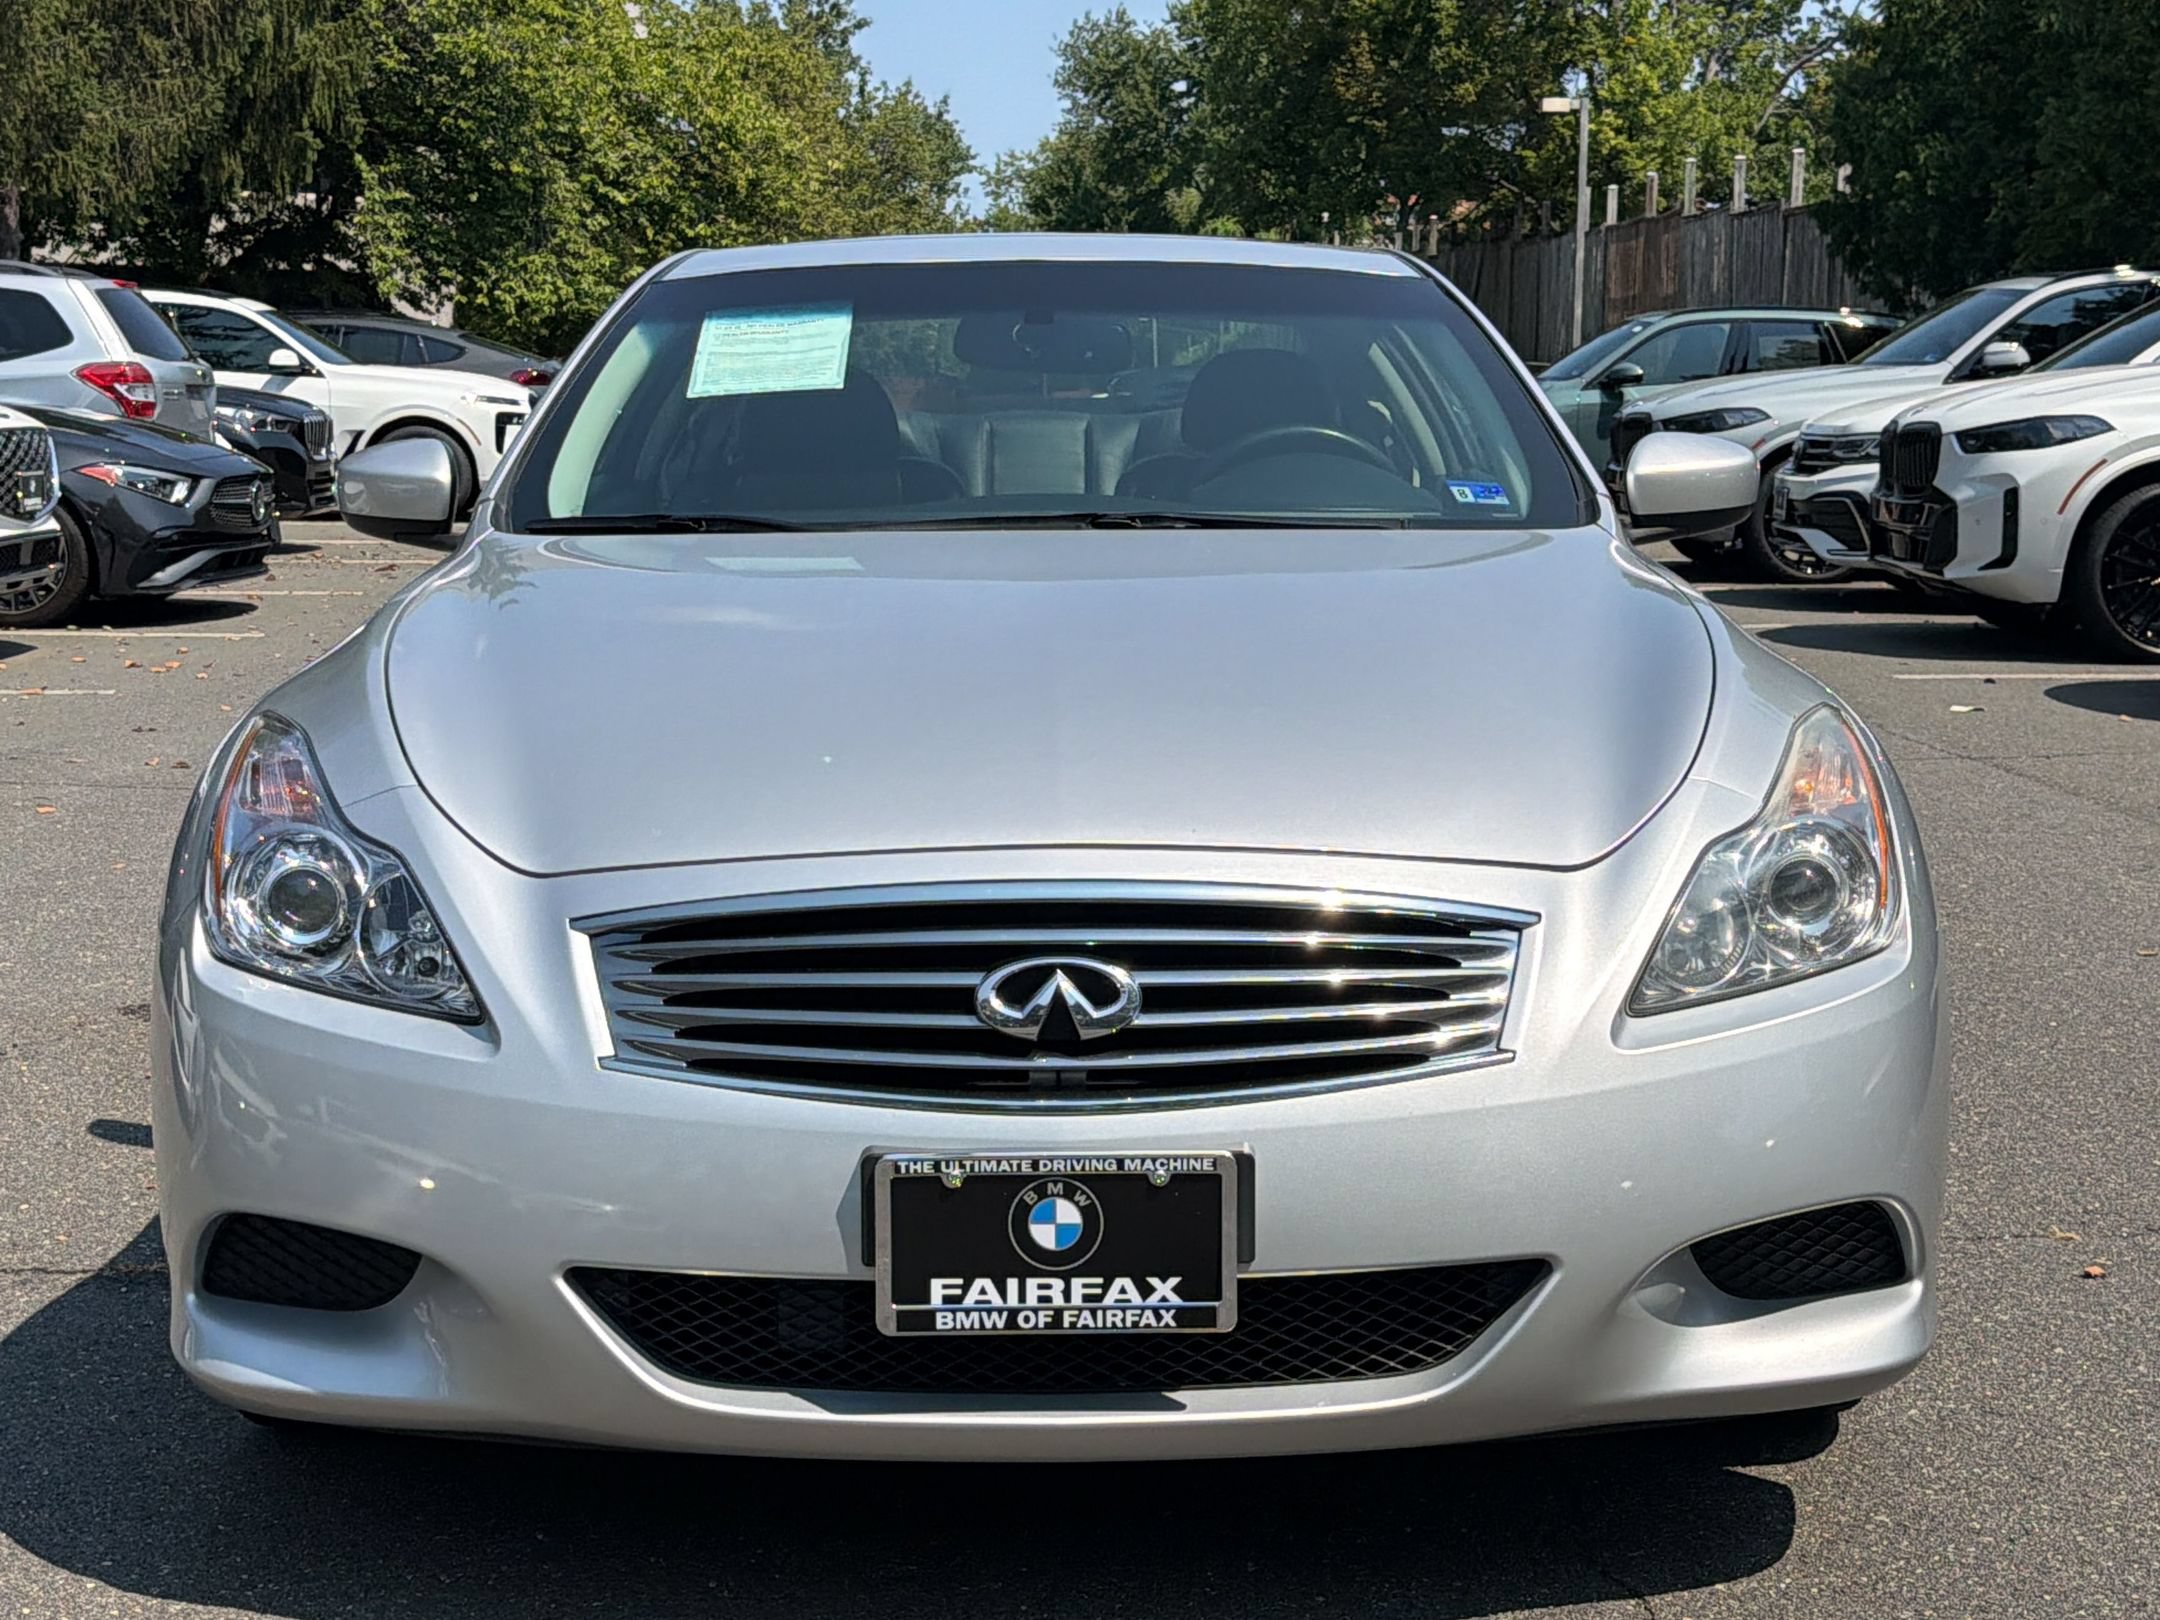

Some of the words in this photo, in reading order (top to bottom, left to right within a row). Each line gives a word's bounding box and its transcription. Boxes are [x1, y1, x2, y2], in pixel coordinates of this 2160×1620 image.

[1457, 488, 1469, 499] 8
[897, 1160, 935, 1174] THE
[940, 1159, 1033, 1174] ULTIMATE
[1039, 1158, 1118, 1172] DRIVING
[1124, 1158, 1214, 1172] MACHINE
[1022, 1182, 1092, 1207] BMW
[930, 1276, 1184, 1305] FAIRFAX
[935, 1310, 1008, 1330] BMW
[1017, 1310, 1054, 1329] OF
[1063, 1309, 1178, 1328] FAIRFAX
